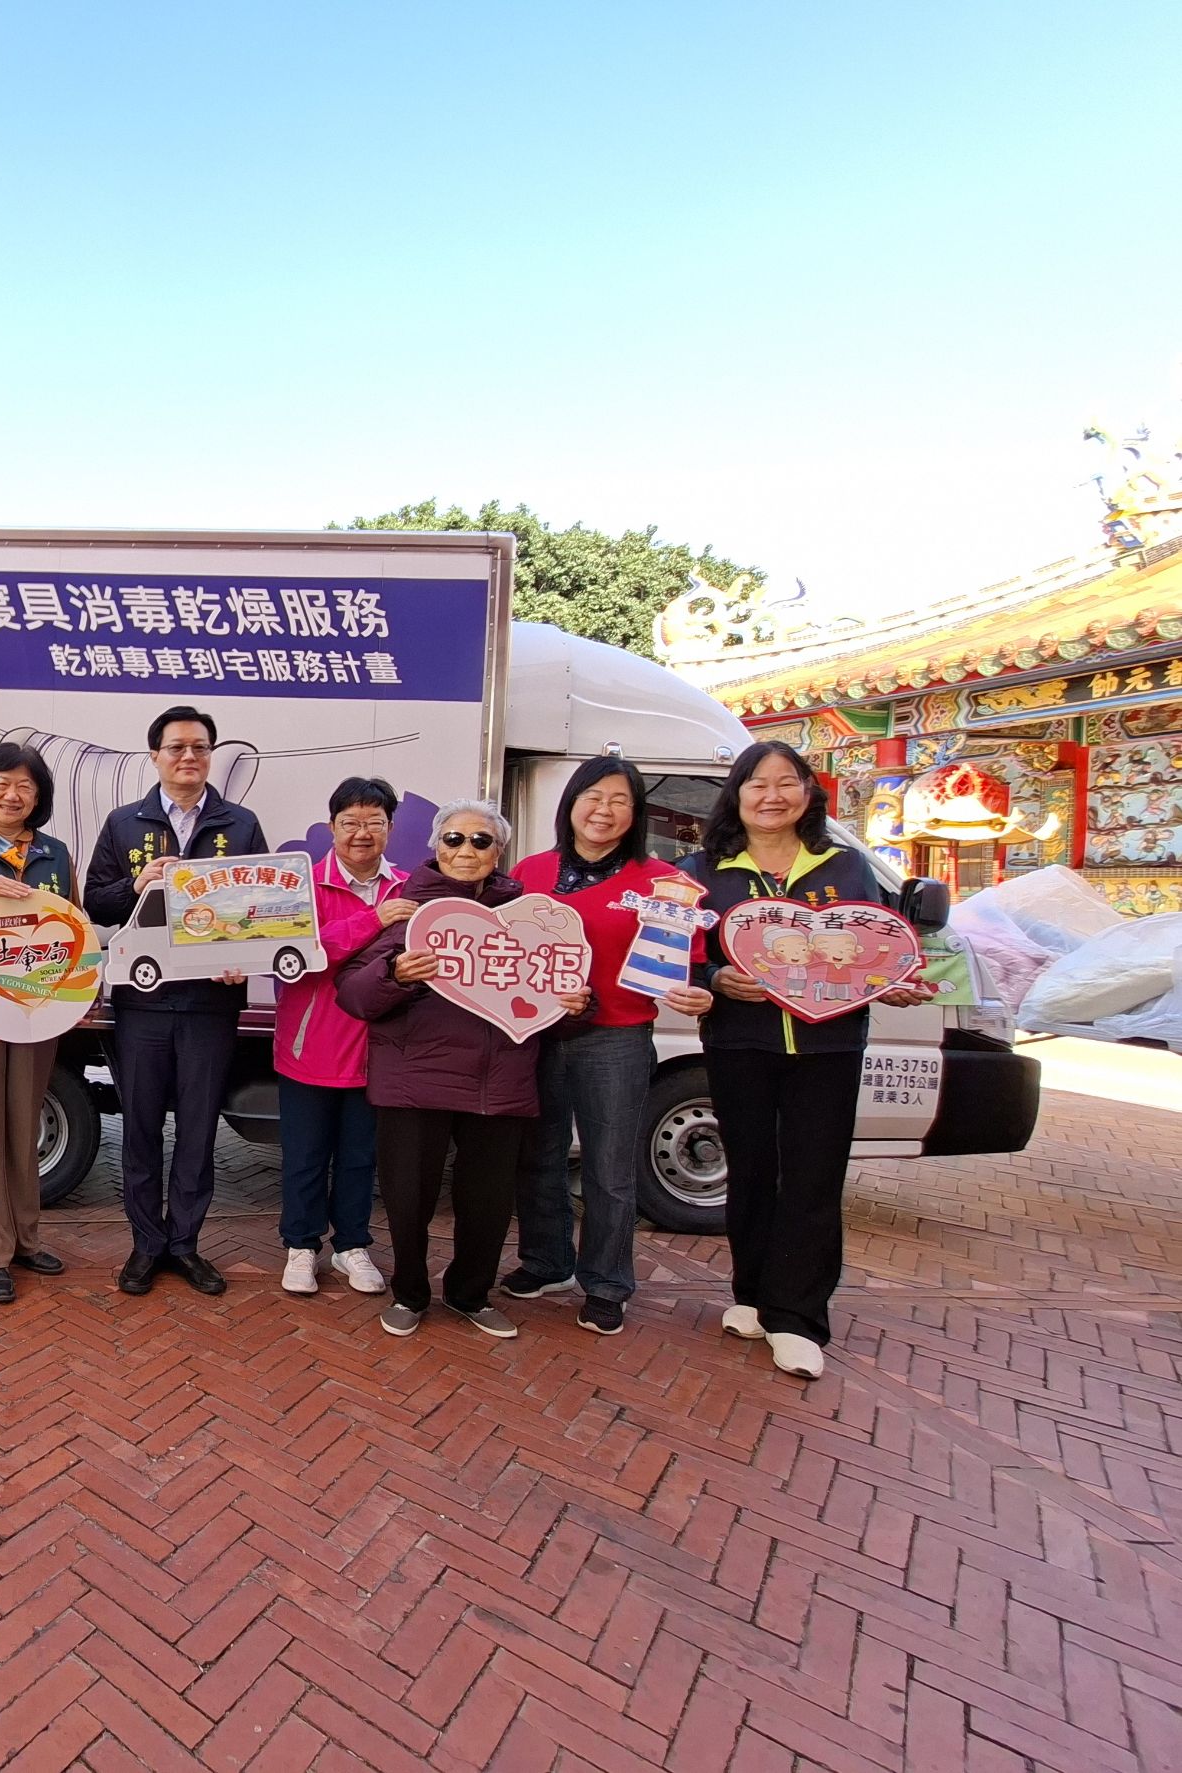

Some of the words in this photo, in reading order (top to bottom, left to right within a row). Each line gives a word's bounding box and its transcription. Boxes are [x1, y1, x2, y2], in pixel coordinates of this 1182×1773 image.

[48, 643, 403, 685] 乾燥專車到宅服務計畫
[730, 907, 906, 938] 守護長者安全
[40, 968, 62, 976] SOCIAL
[64, 966, 89, 974] AFFAIRS
[6, 978, 58, 998] GOVERNMENT
[864, 1057, 938, 1074] BAR-3750
